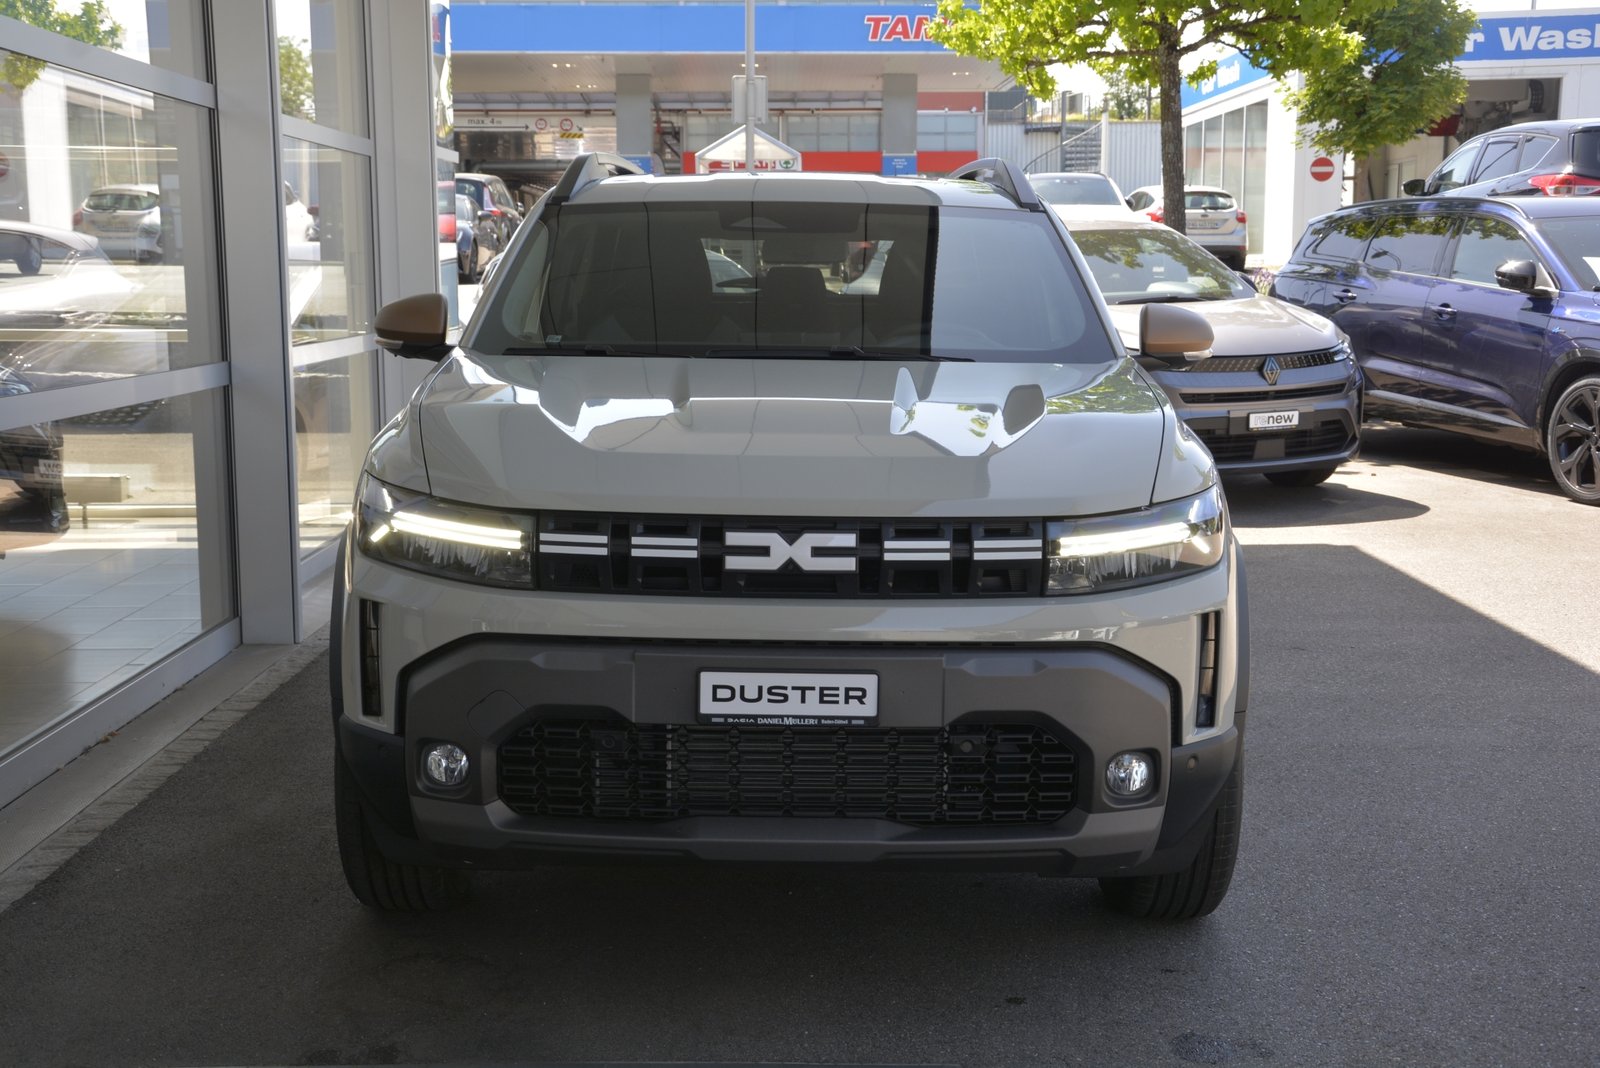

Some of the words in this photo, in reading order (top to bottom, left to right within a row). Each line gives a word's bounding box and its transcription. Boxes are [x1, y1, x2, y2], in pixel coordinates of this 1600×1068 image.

[1498, 24, 1600, 52] Was
[1254, 414, 1294, 426] renew
[711, 684, 868, 705] DUSTER
